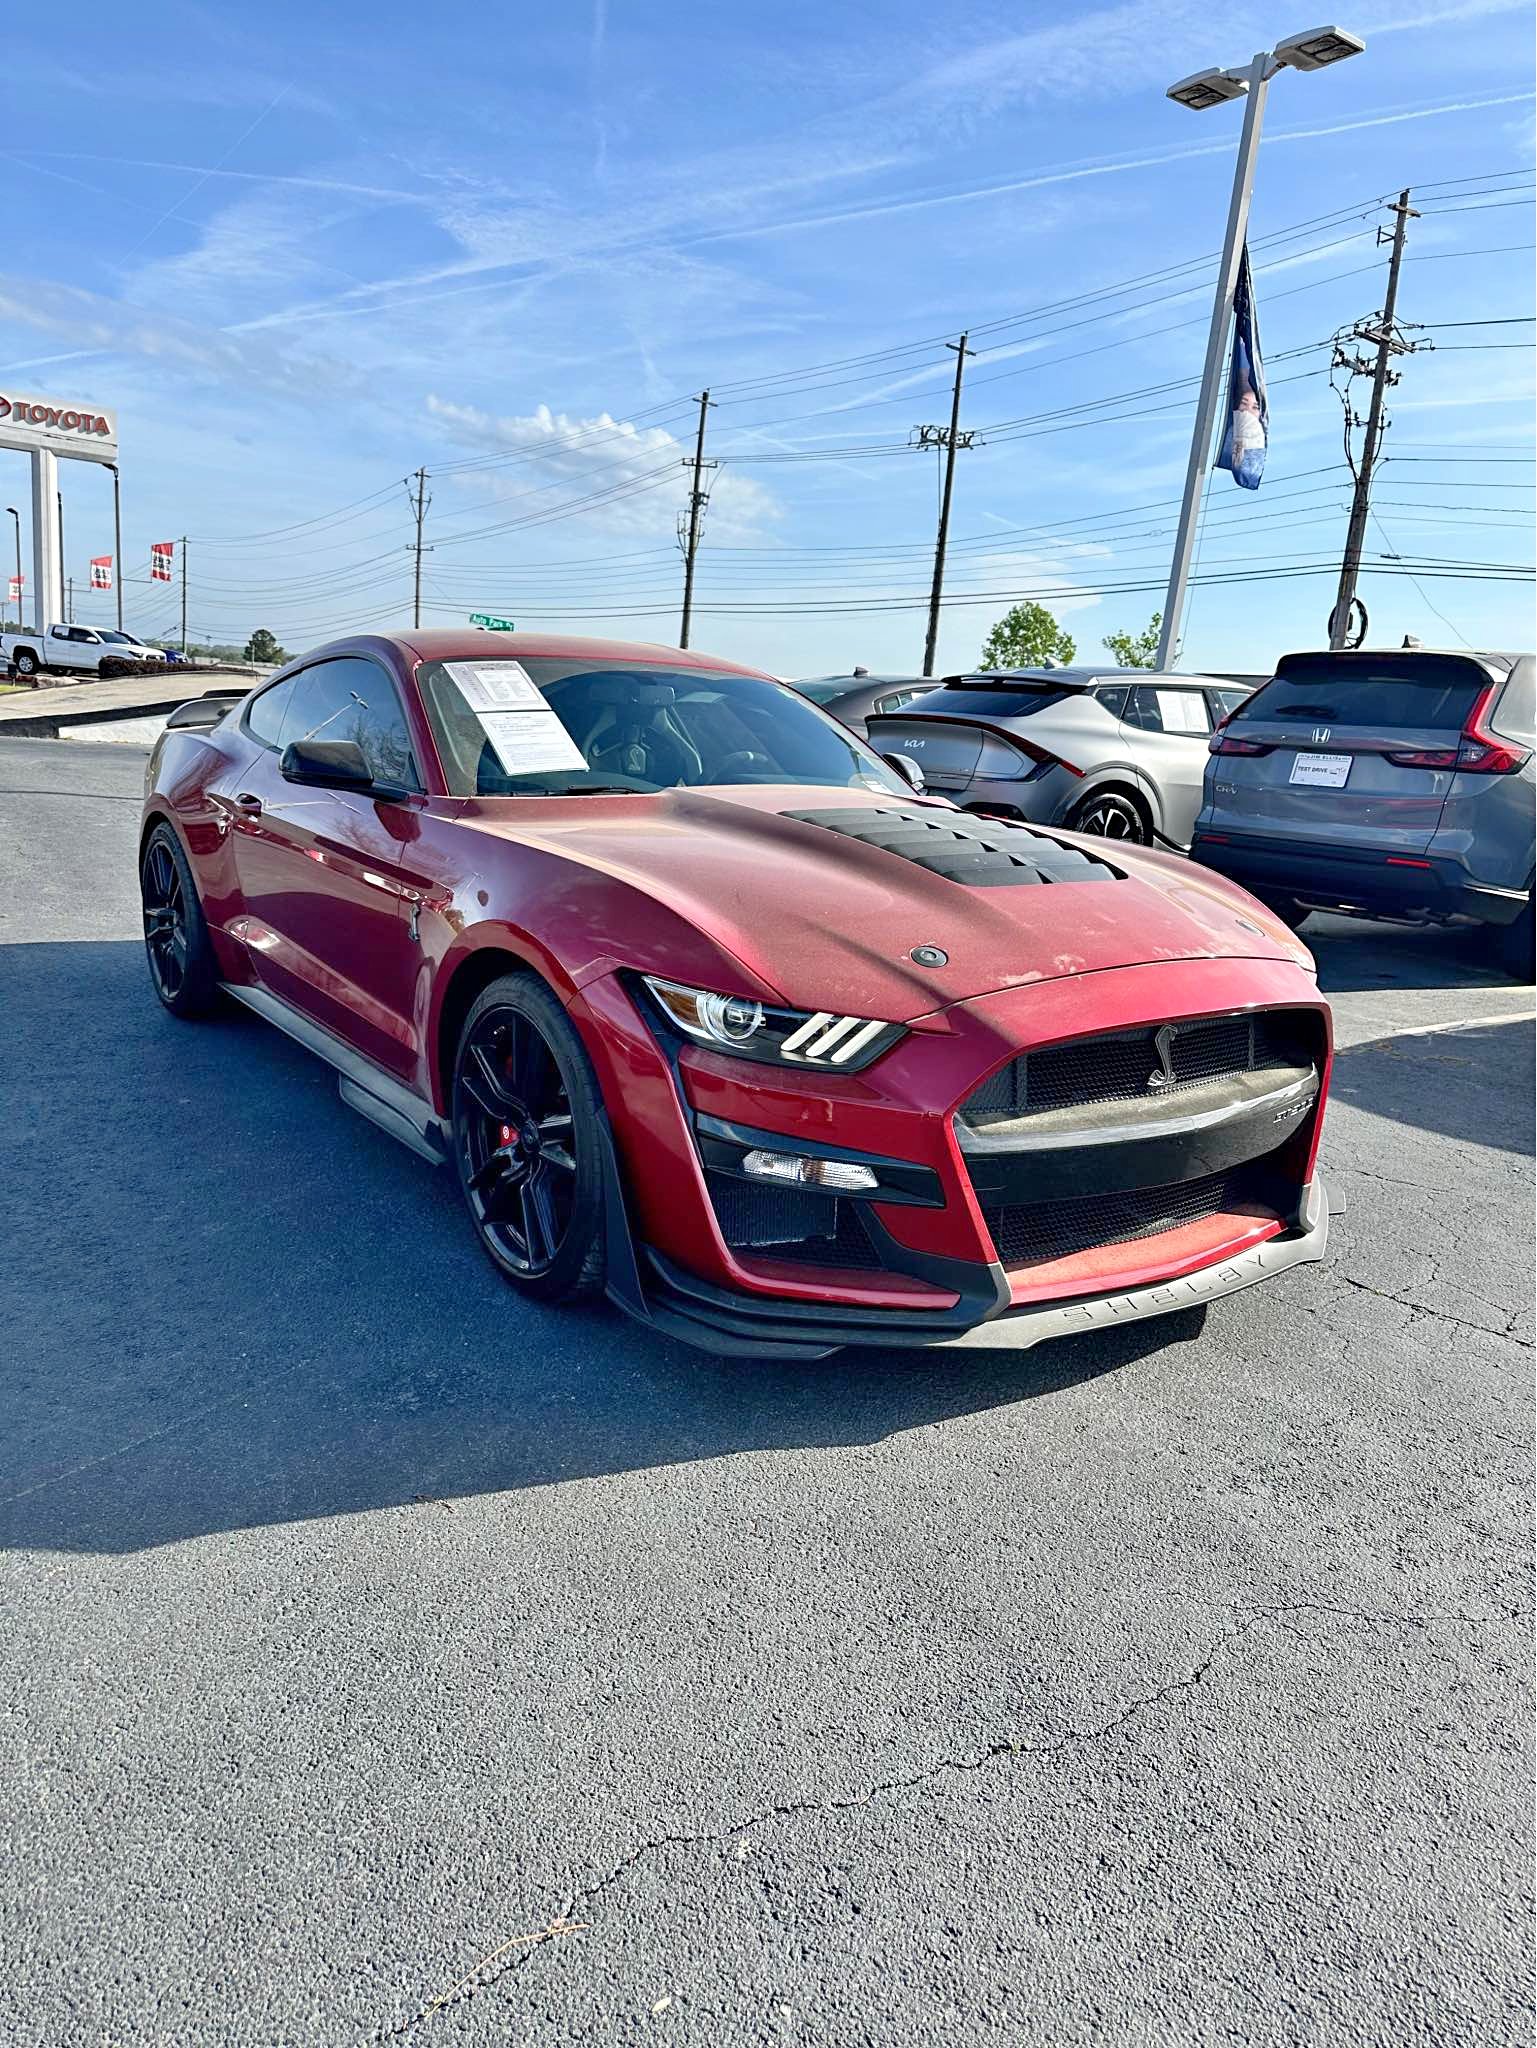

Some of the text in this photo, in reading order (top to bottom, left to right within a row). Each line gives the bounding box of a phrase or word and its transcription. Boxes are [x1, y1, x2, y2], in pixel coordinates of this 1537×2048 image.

[13, 402, 110, 436] TOYOTA
[473, 615, 486, 624] Auto
[904, 739, 925, 748] KIA
[1215, 784, 1238, 794] CR-V
[1063, 1253, 1266, 1323] SHELBY
